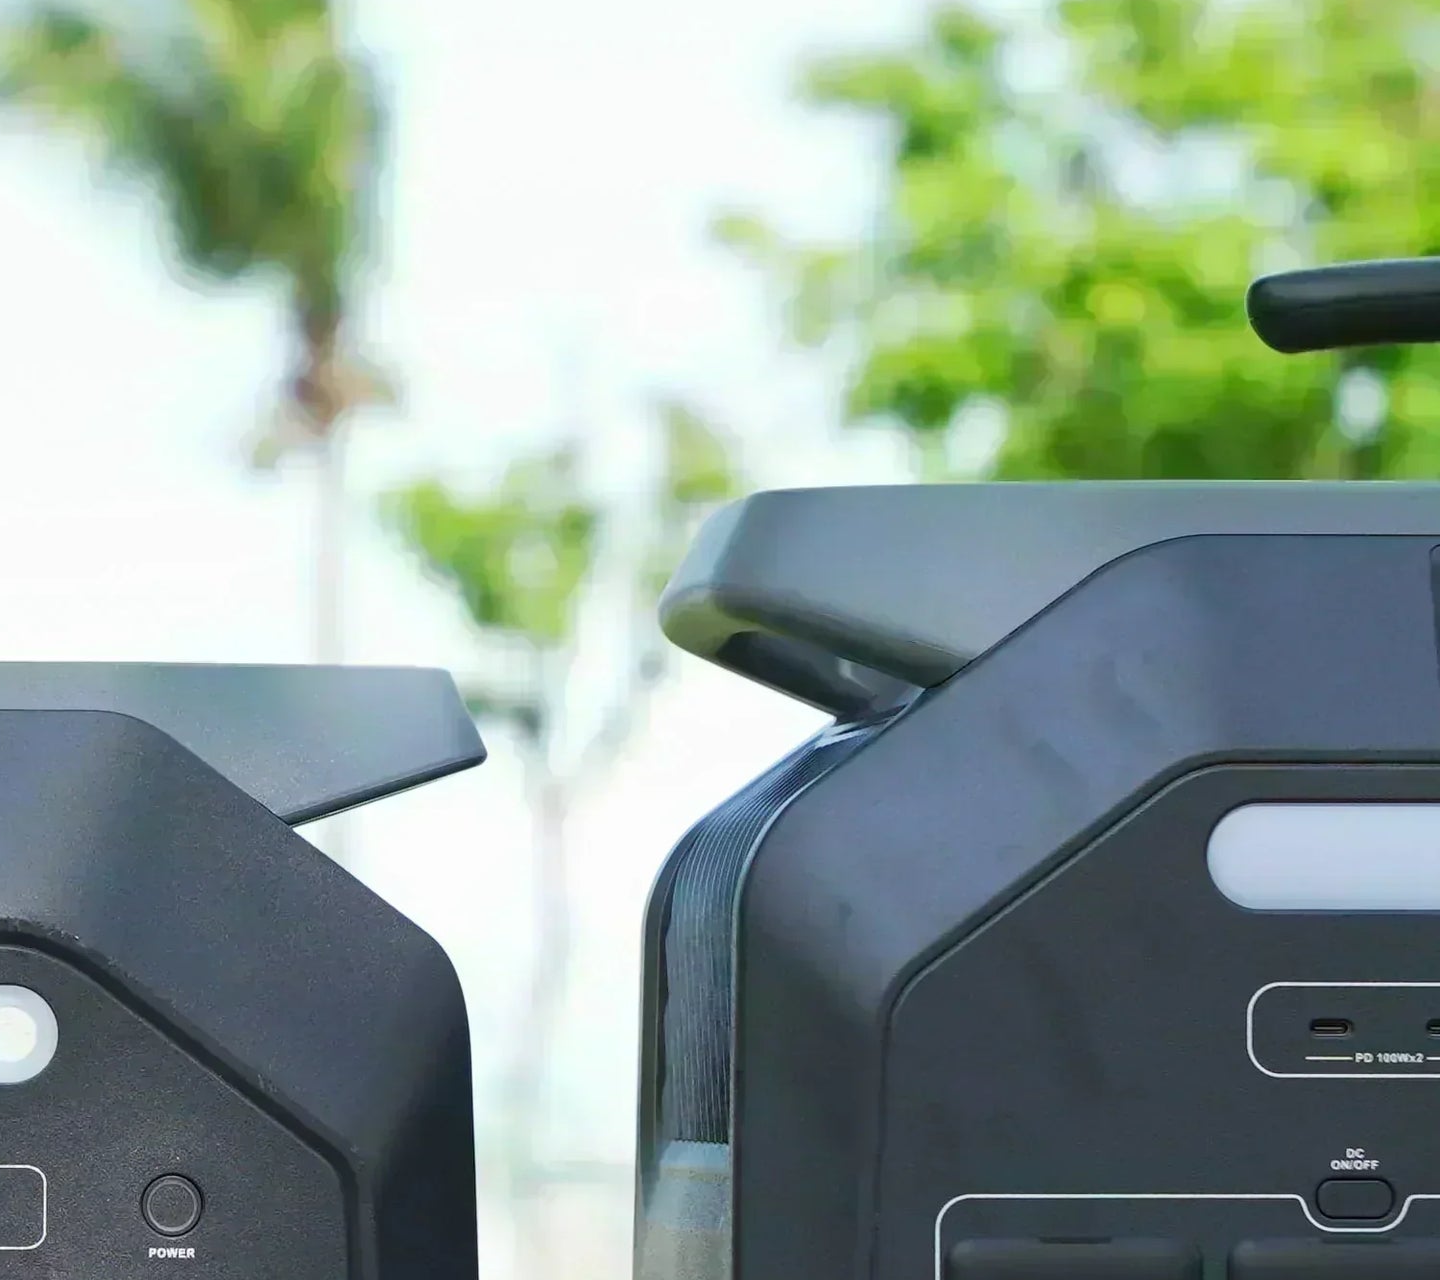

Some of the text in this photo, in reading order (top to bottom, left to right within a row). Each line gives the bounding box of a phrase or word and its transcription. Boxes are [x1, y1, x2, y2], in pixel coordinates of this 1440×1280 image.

[1355, 1052, 1425, 1064] PD 100Wx2
[1345, 1147, 1365, 1159] DC
[1330, 1159, 1380, 1171] ON/OFF
[148, 1247, 196, 1259] POWER
